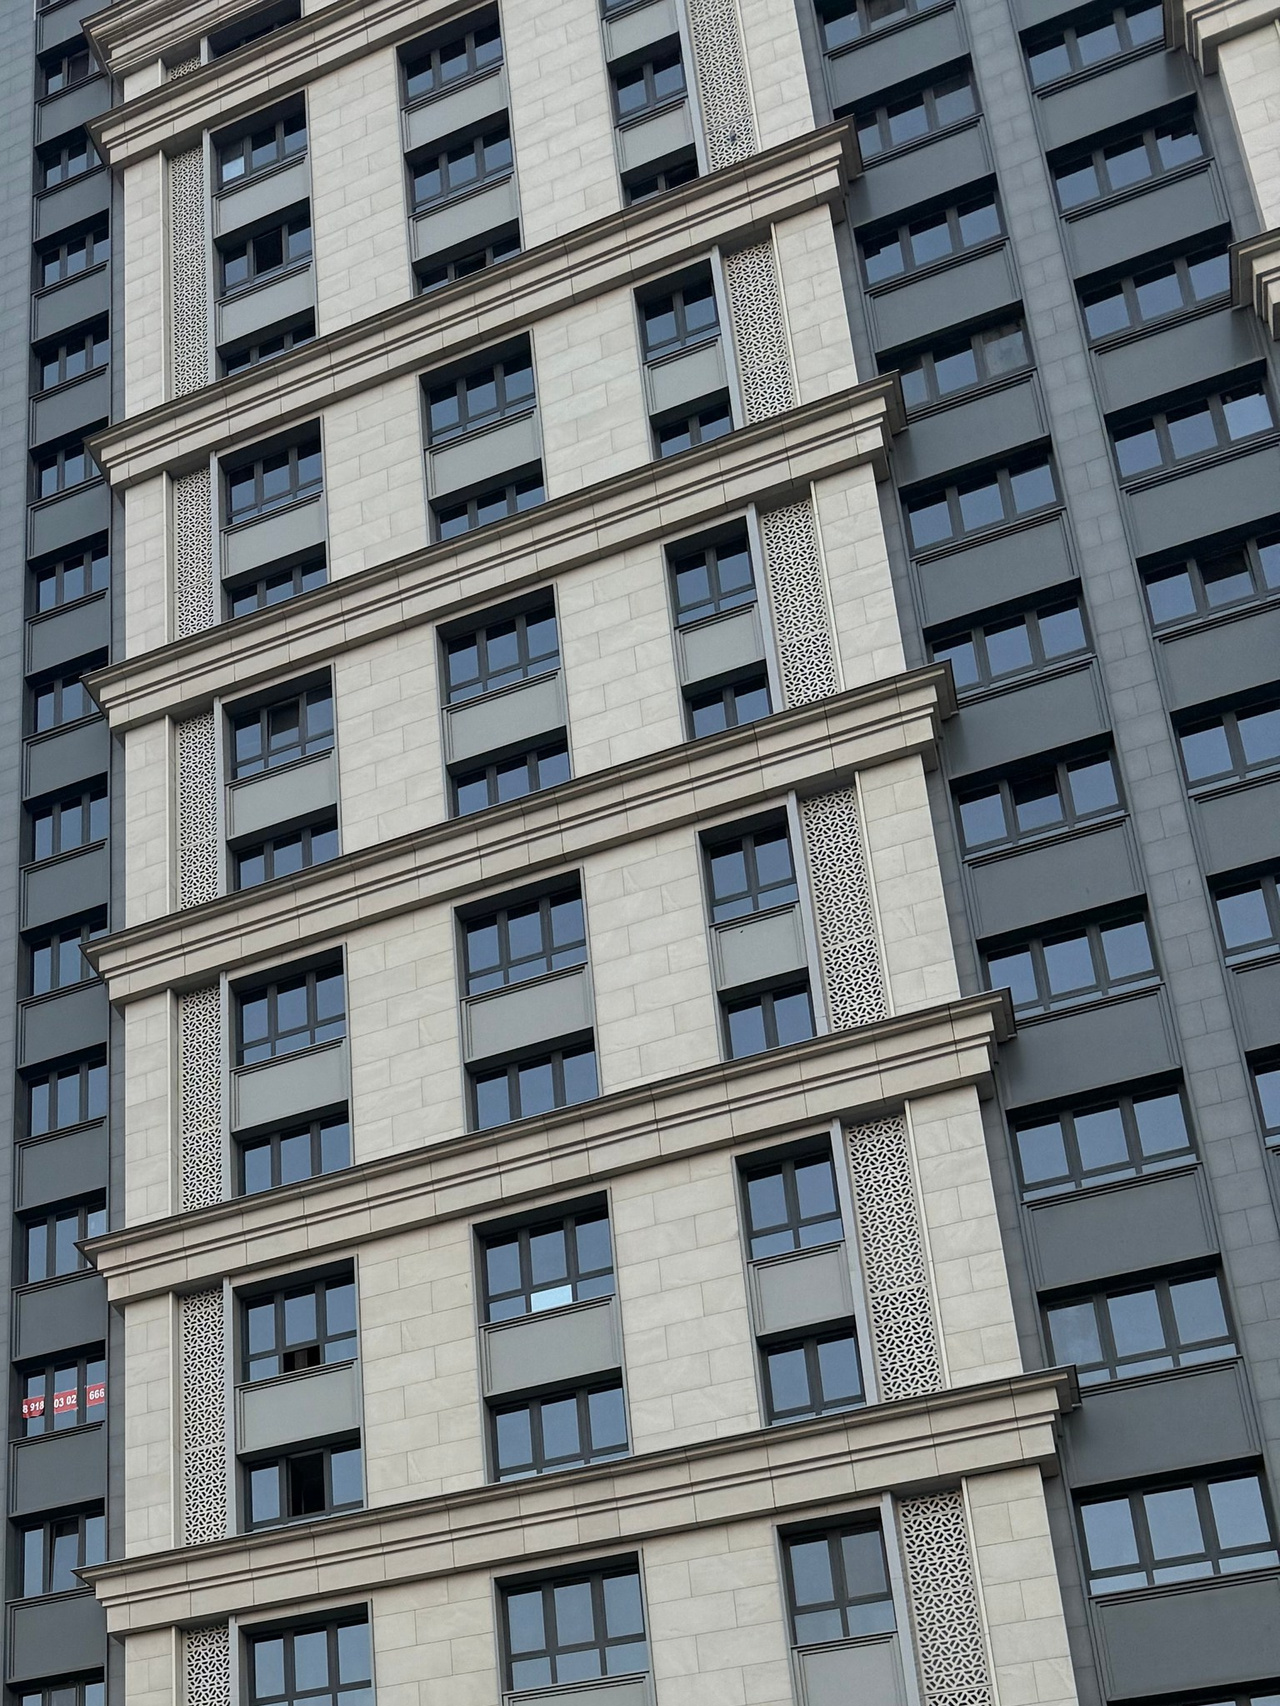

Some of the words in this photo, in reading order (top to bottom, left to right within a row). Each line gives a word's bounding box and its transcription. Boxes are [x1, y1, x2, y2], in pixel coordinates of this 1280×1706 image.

[22, 1404, 29, 1414] 8
[29, 1400, 45, 1412] 918
[54, 1398, 64, 1408] 03
[66, 1394, 77, 1405] 02
[89, 1388, 105, 1400] 666
